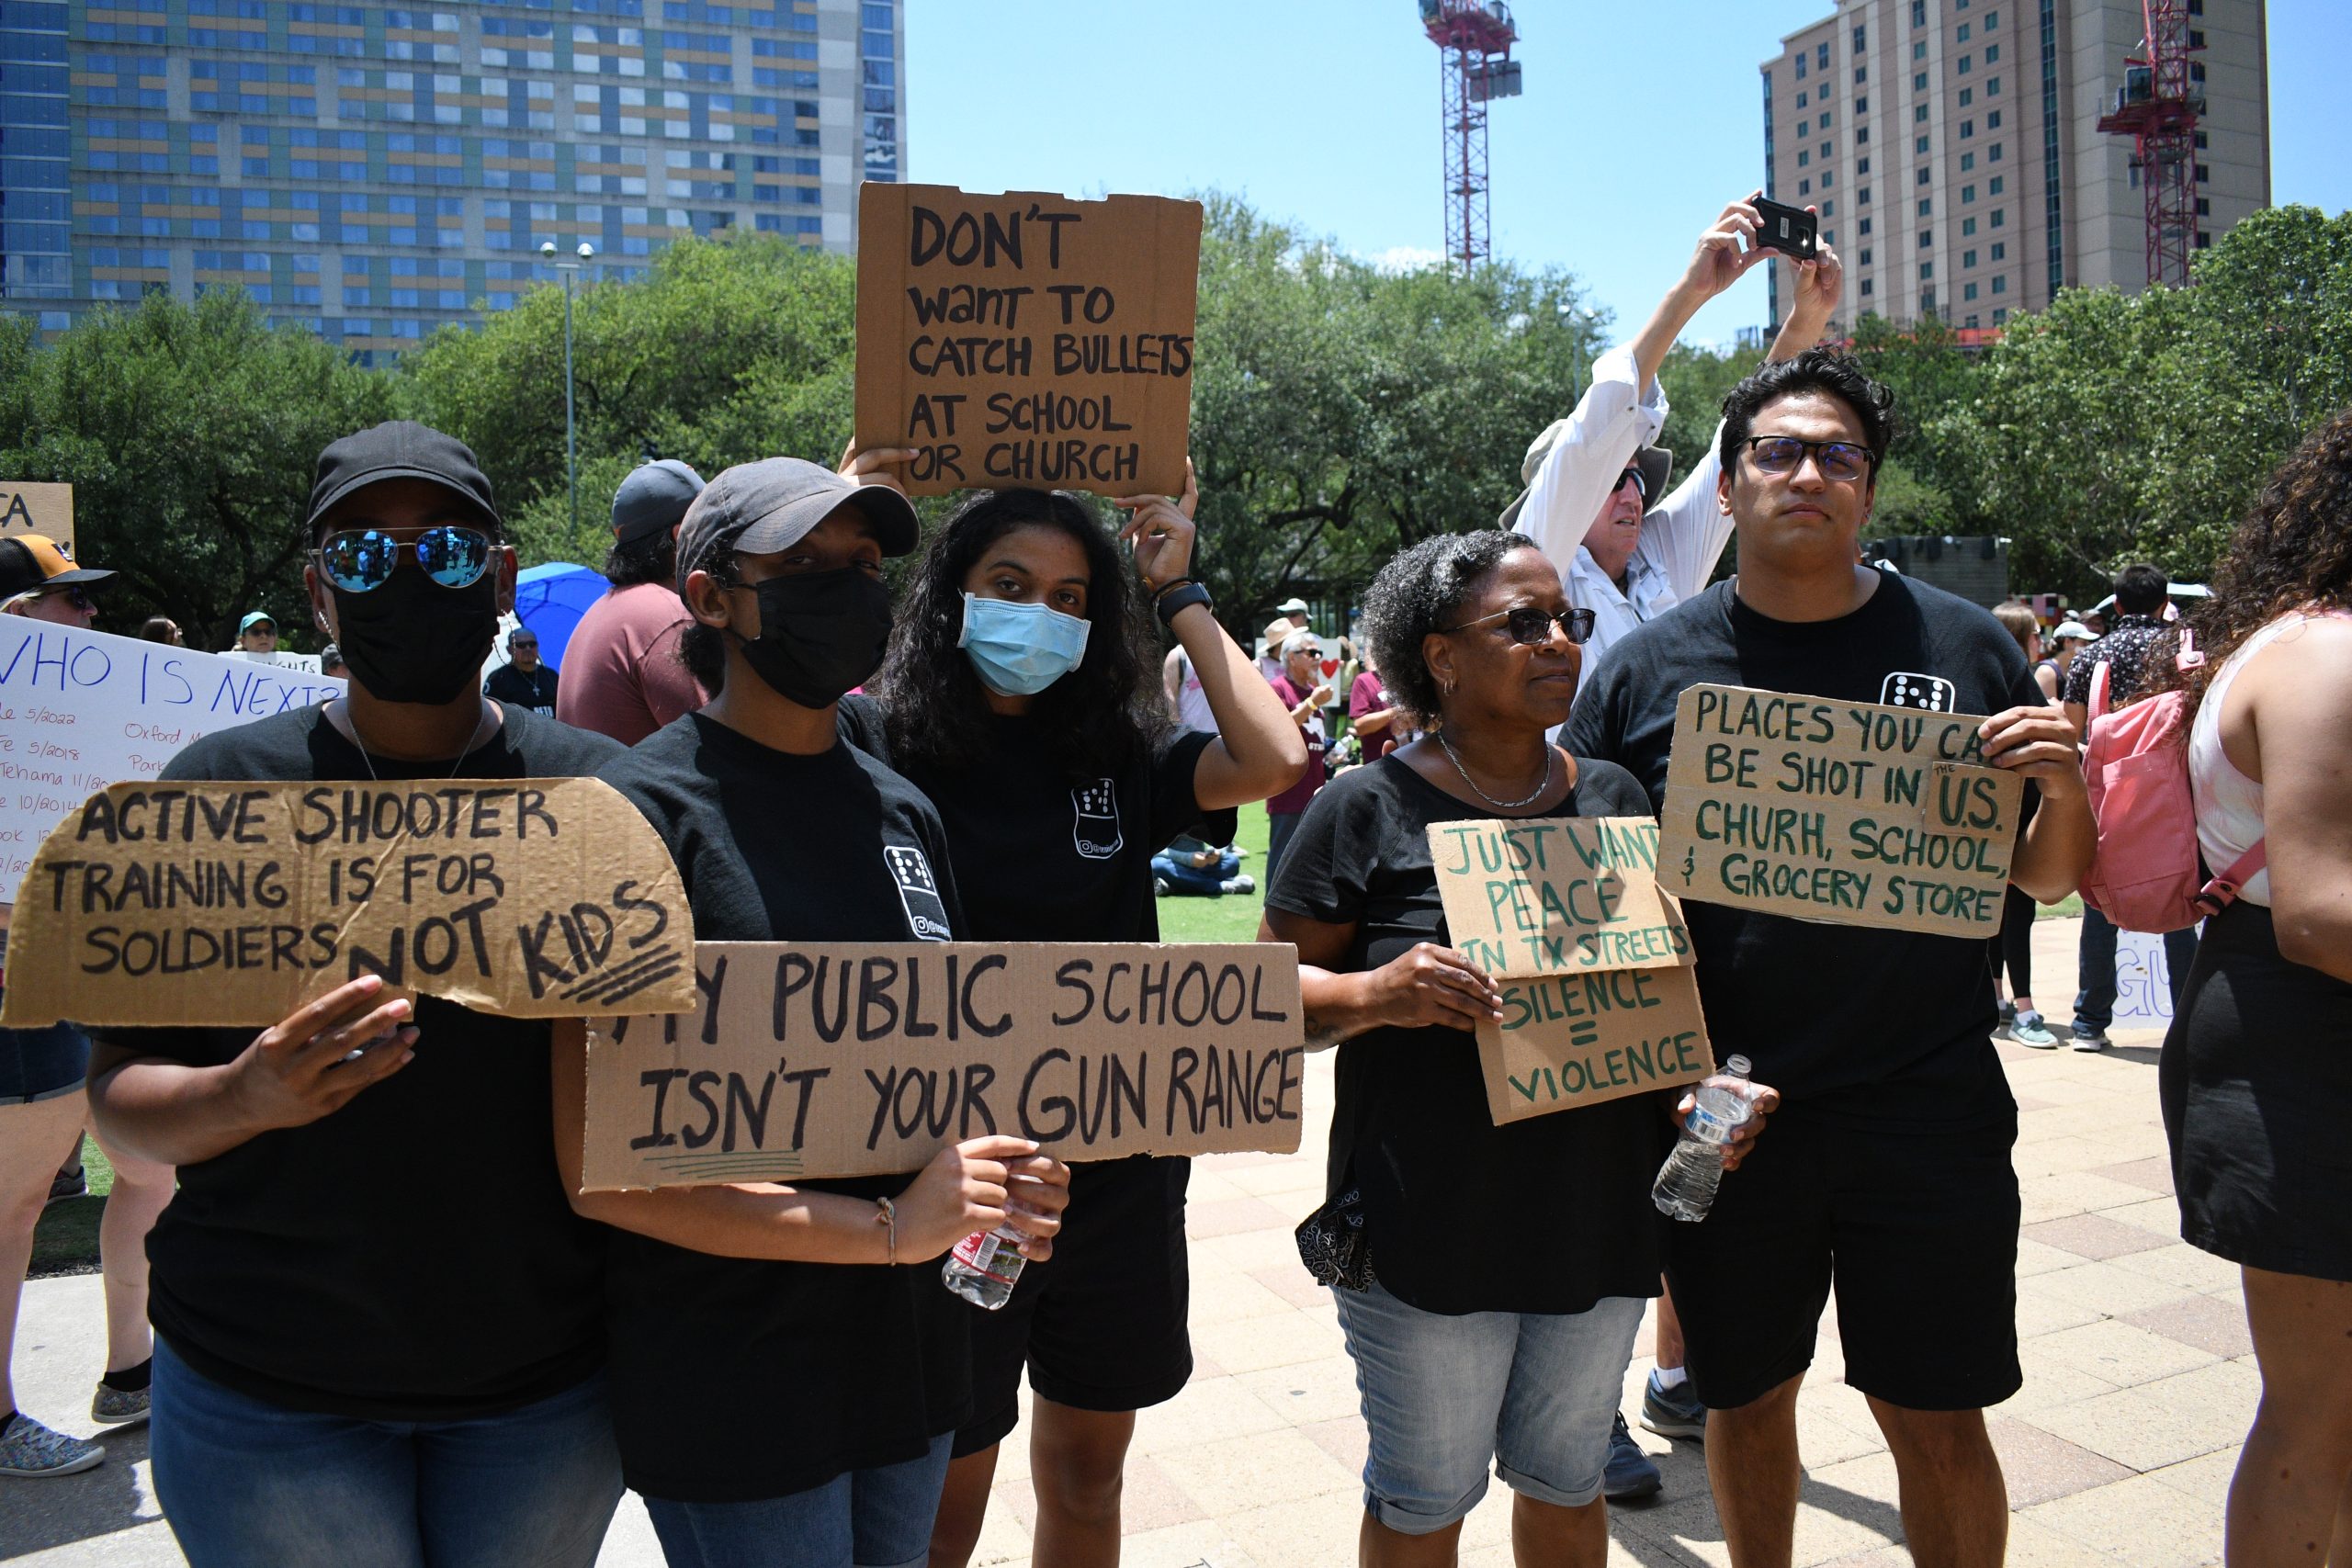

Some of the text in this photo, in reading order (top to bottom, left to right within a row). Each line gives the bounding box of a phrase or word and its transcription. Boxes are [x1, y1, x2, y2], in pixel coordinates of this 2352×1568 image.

[910, 203, 1081, 269] DON'T
[1046, 285, 1114, 325] TO
[909, 333, 1194, 378] CATCH BULLETS
[909, 391, 1132, 438] AT SCHOOL
[910, 439, 1138, 481] OR CHURCH
[141, 652, 193, 705] IS
[25, 706, 75, 727] 5/2022
[125, 723, 180, 745] Oxford
[1696, 690, 1984, 762] PLACES YOU CA
[28, 740, 80, 761] 5/2018
[129, 755, 166, 772] Park
[1705, 743, 2003, 832] BE SHOT IN THE U.S.
[76, 788, 559, 844] ACTIVE SHOOTER
[1443, 824, 1659, 875] JUST WANT
[1849, 818, 2007, 879] SCHOOL,
[45, 860, 288, 914] TRAINING
[332, 857, 376, 906] IS
[402, 853, 504, 904] FOR
[1486, 878, 1628, 934] PEACE
[1720, 852, 1871, 911] GROCERY
[1883, 875, 2002, 921] STORE
[81, 880, 669, 999] SOLDIERS NOT KIDS
[1521, 936, 1567, 971] TX
[1571, 925, 1689, 965] STREETS
[774, 953, 1012, 1043] PUBLIC
[1053, 961, 1288, 1028] SCHOOL
[1501, 970, 1661, 1030] SILENCE
[1508, 1032, 1702, 1102] VIOLENCE
[631, 1043, 1305, 1153] ISN'T YOUR GUN RANGE
